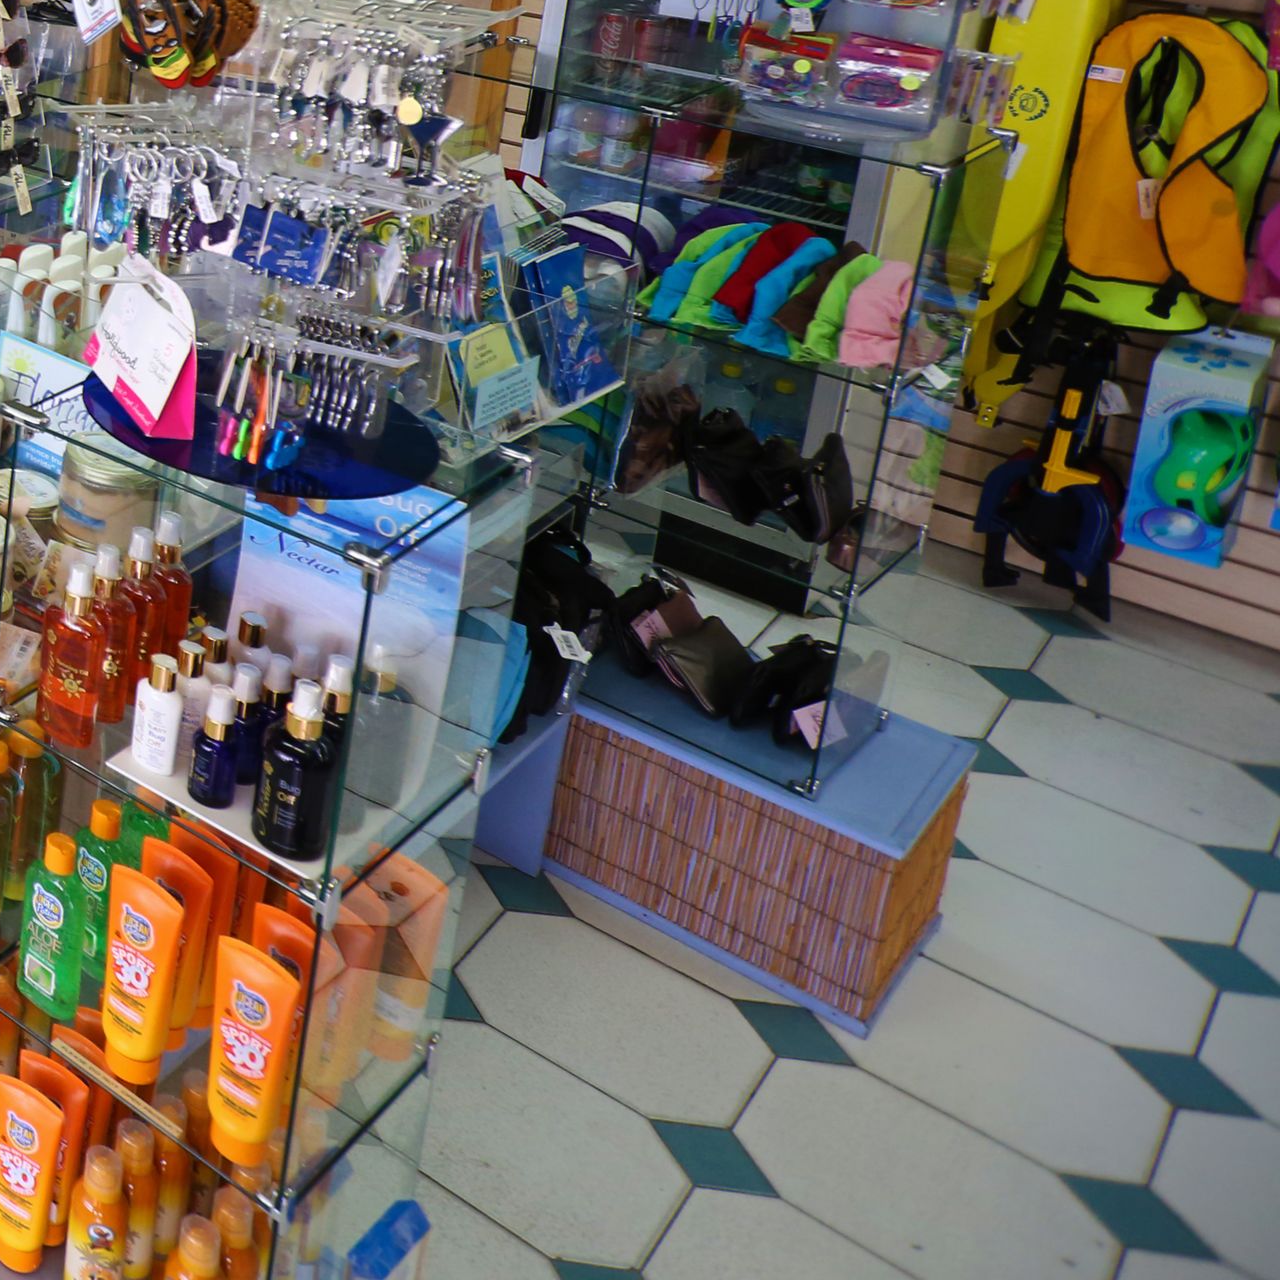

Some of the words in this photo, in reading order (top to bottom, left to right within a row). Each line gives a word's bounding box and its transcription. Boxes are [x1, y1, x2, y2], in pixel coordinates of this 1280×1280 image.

[378, 494, 433, 529] Bug
[249, 531, 341, 576] Nectar
[276, 791, 298, 806] Off
[278, 779, 301, 797] Bug
[26, 921, 63, 956] ALOE
[28, 935, 56, 964] GEL
[111, 946, 156, 977] SPORT
[114, 958, 150, 992] 30
[219, 1023, 272, 1057] SPORT
[224, 1036, 266, 1072] 30
[2, 1159, 36, 1191] 30
